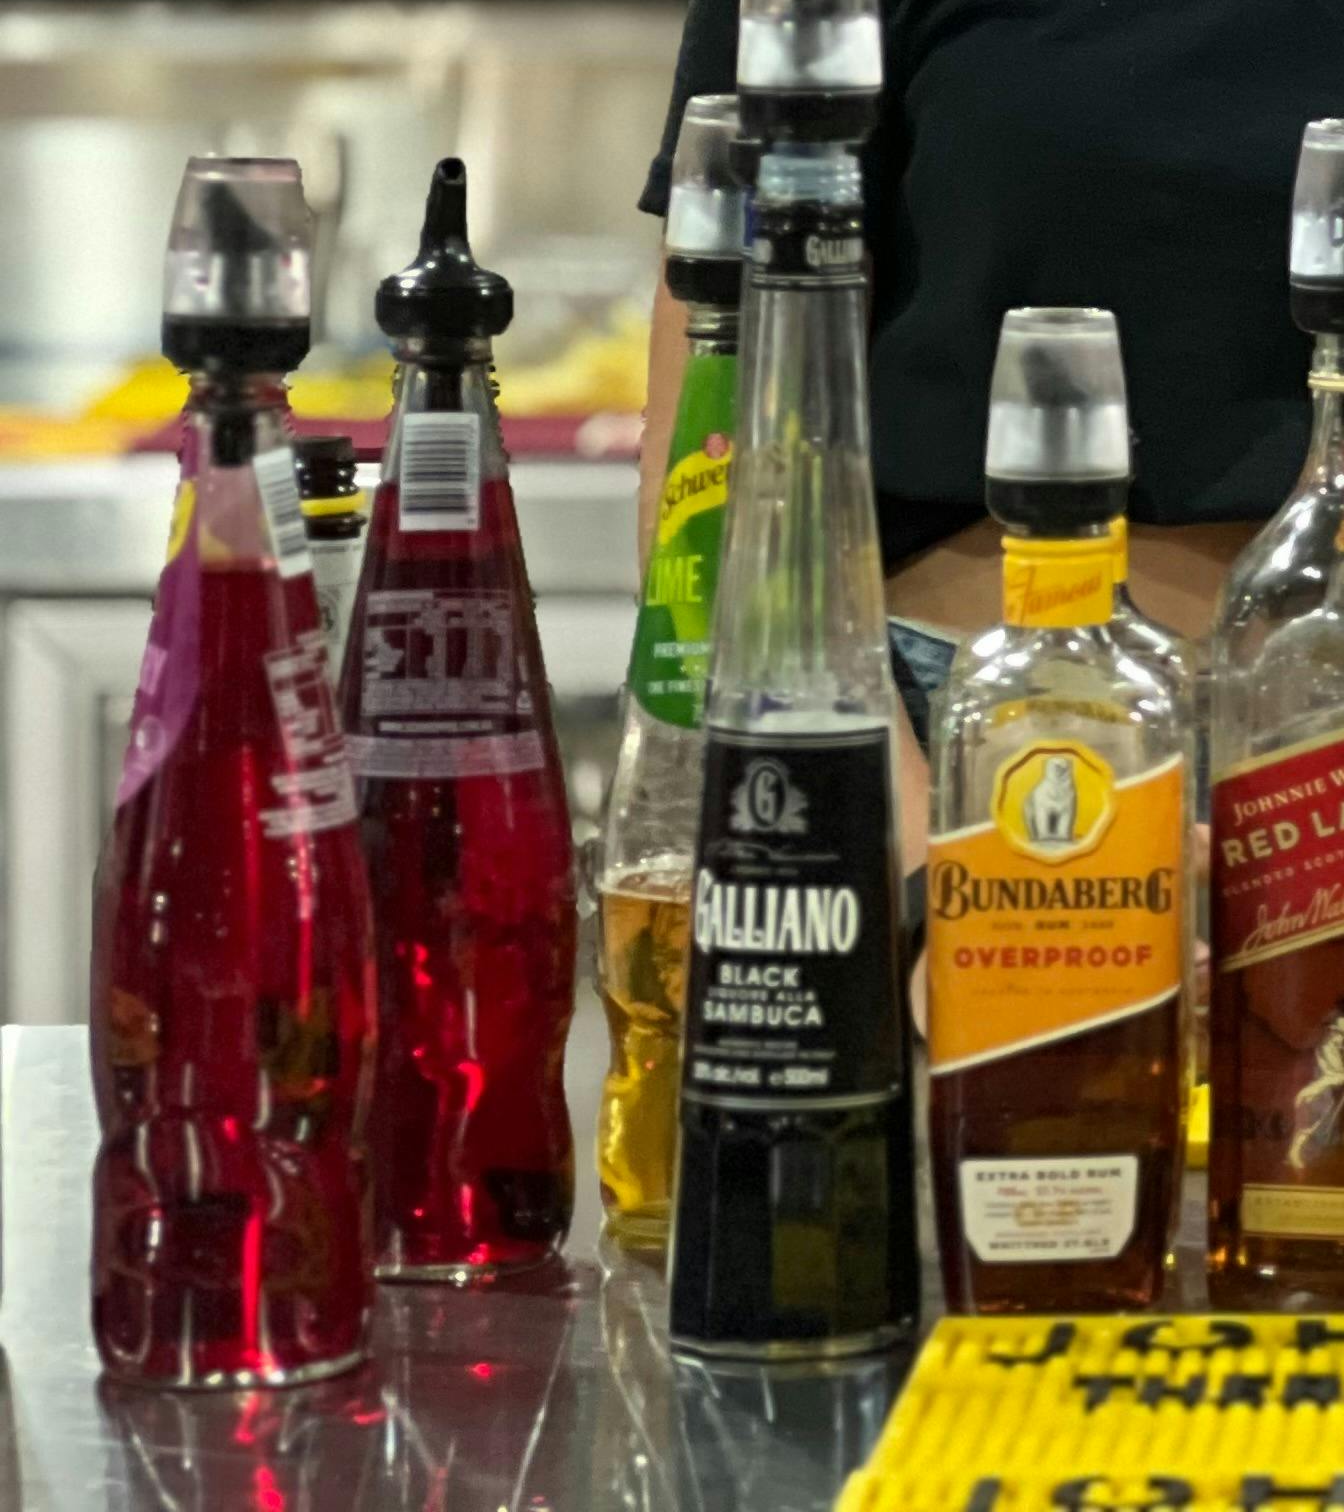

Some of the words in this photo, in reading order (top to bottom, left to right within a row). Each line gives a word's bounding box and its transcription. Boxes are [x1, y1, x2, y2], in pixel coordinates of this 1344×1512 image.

[1233, 777, 1327, 827] JOHNNIE
[1221, 821, 1300, 867] RED
[933, 860, 1176, 921] BUNDABERG
[695, 868, 859, 954] GALLIANO
[719, 963, 799, 987] BLACK
[954, 945, 1153, 969] OVERPROOF
[703, 1000, 823, 1026] SAMBUCA
[976, 1170, 1030, 1182] EXTRA
